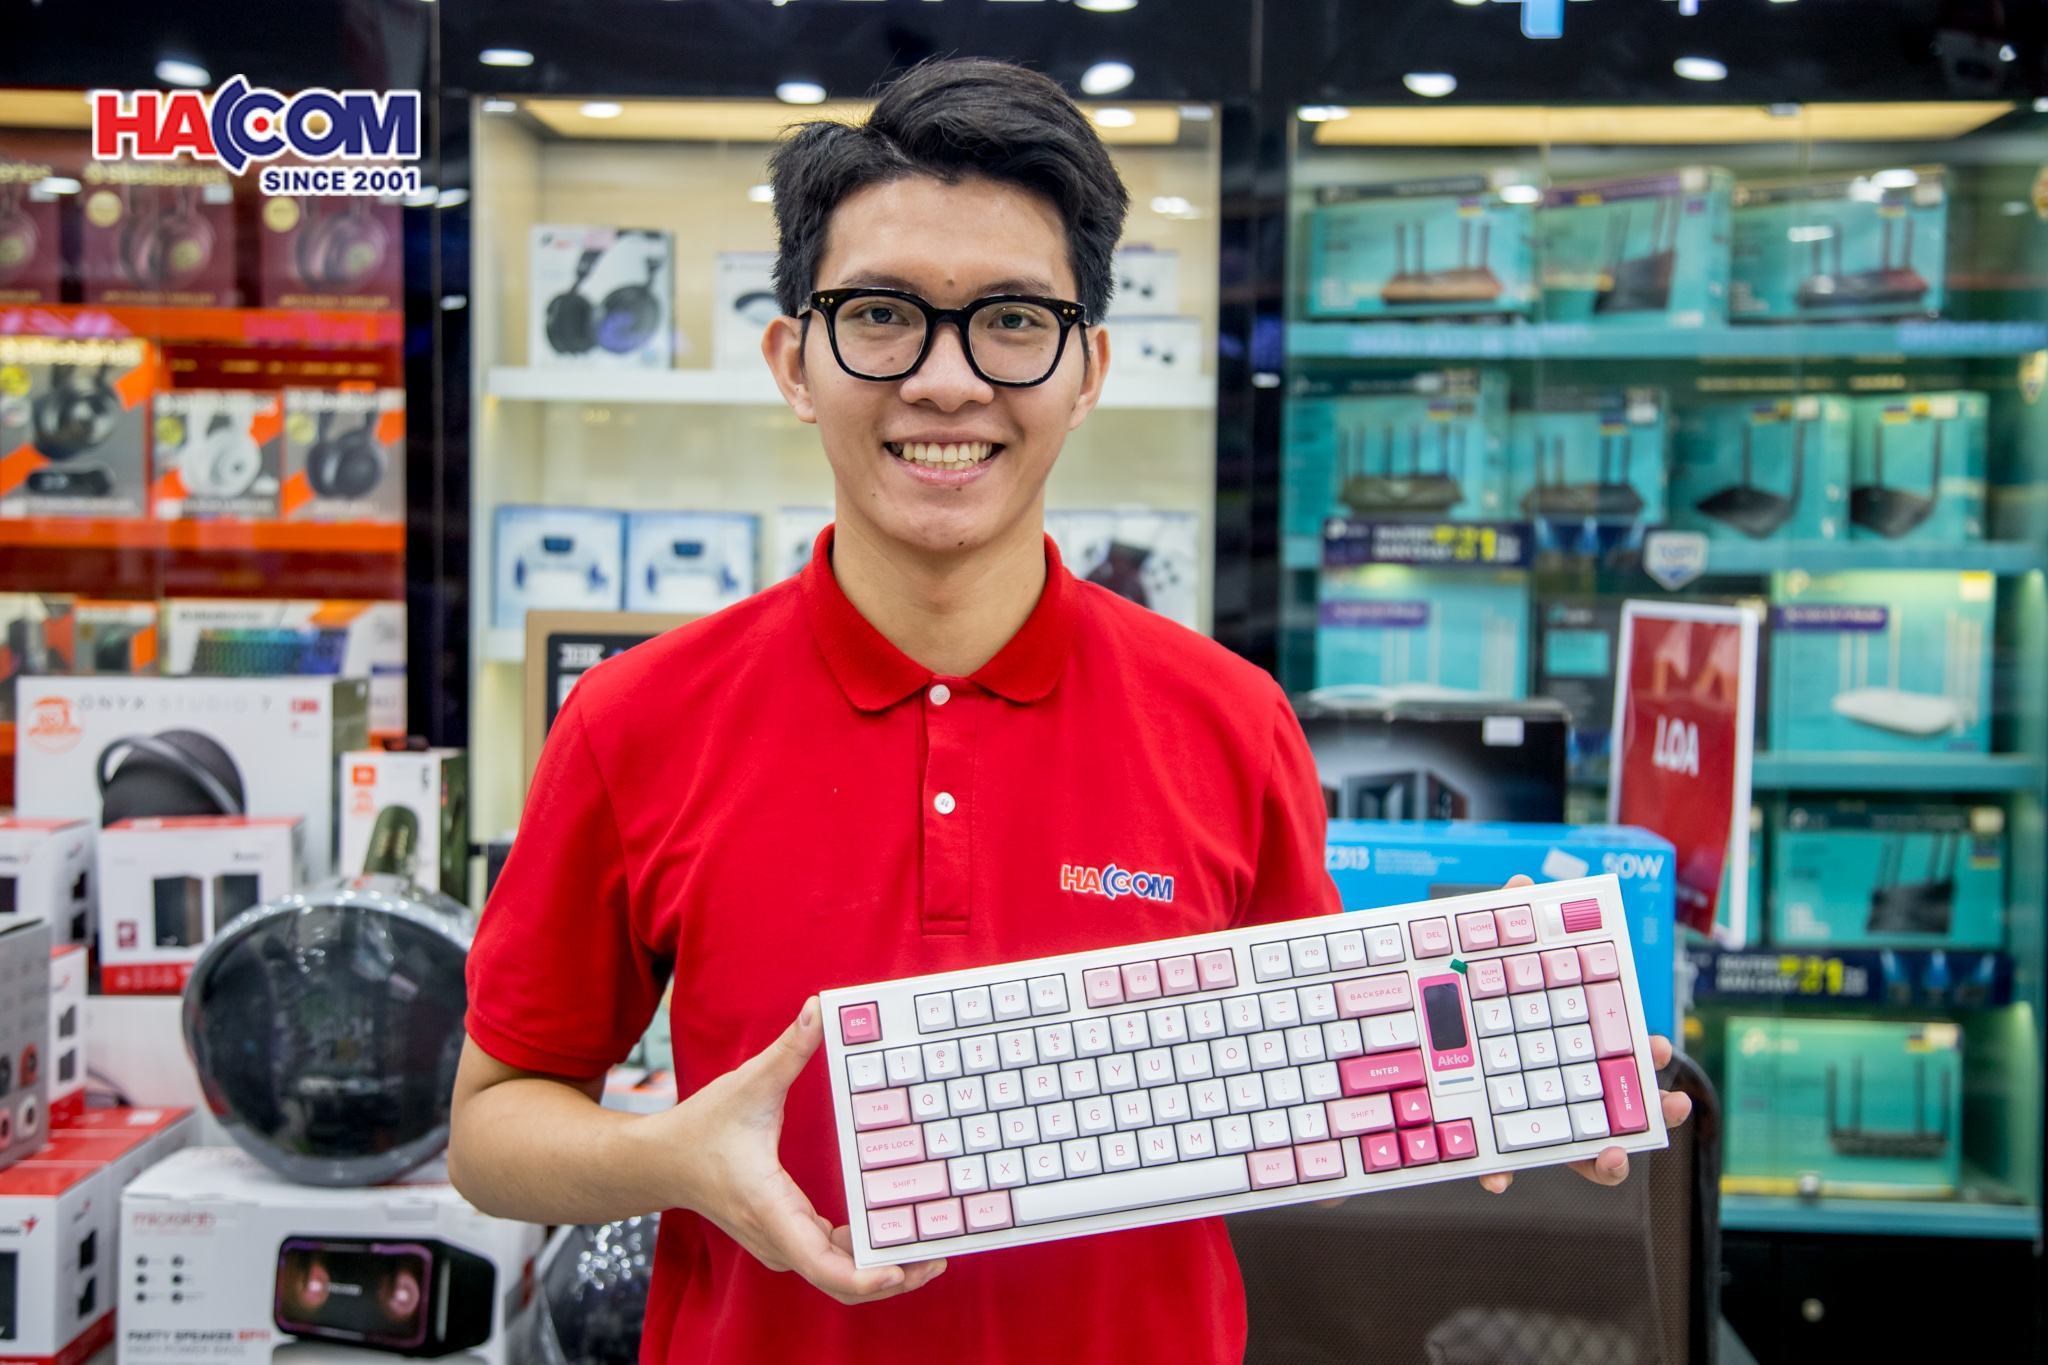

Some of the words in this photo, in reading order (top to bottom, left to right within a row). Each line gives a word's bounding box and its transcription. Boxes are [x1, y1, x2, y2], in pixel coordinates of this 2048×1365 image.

[1653, 714, 1699, 777] LOA
[1469, 923, 1493, 933] HOME
[1509, 918, 1528, 928] END
[1425, 931, 1442, 940] DEL
[1343, 943, 1356, 953] F11
[1379, 938, 1393, 947] F12
[1268, 954, 1280, 963] F9
[1304, 948, 1319, 958] F10
[1136, 974, 1148, 983] F6
[1174, 968, 1185, 976] F7
[1481, 968, 1499, 977] NUM
[1098, 979, 1111, 988] F5
[1480, 975, 1503, 986] LOCK
[1004, 994, 1017, 1003] F3
[1041, 989, 1054, 997] F4
[1350, 987, 1402, 1000] BACKSPACE
[929, 1006, 940, 1015] F1
[967, 1000, 978, 1009] F2
[1529, 1003, 1539, 1015] 8
[1567, 998, 1577, 1010] 9
[1491, 1008, 1500, 1021] 7
[850, 1017, 867, 1027] ESC
[1263, 1041, 1273, 1054] P
[1535, 1042, 1546, 1054] 5
[1573, 1037, 1583, 1050] 6
[1225, 1047, 1238, 1060] O
[1437, 1053, 1470, 1067] Akko
[1498, 1049, 1508, 1060] 4
[1111, 1064, 1122, 1077] Y
[1149, 1058, 1161, 1072] U
[1370, 1066, 1399, 1076] ENTER
[1037, 1076, 1048, 1089] R
[1074, 1070, 1084, 1083] T
[1582, 1074, 1592, 1087] 3
[998, 1082, 1009, 1095] E
[1241, 1087, 1251, 1099] L
[1543, 1080, 1554, 1093] 2
[1620, 1076, 1632, 1110] ENTER
[922, 1093, 934, 1106] Q
[957, 1087, 973, 1101] W
[1203, 1091, 1215, 1104] K
[871, 1103, 889, 1112] TAB
[1127, 1103, 1139, 1116] H
[1168, 1097, 1176, 1110] J
[1052, 1114, 1061, 1127] F
[1089, 1108, 1101, 1121] G
[1350, 1108, 1375, 1120] SHIFT
[975, 1126, 986, 1139] S
[1013, 1121, 1025, 1133] D
[1530, 1121, 1541, 1134] 0
[937, 1132, 948, 1145] A
[1152, 1138, 1164, 1152] N
[1189, 1132, 1203, 1146] M
[865, 1143, 889, 1153] CAPS
[891, 1139, 915, 1150] LOCK
[1114, 1144, 1126, 1157] B
[1038, 1155, 1049, 1169] C
[1075, 1150, 1087, 1163] V
[1314, 1156, 1328, 1165] FN
[999, 1162, 1011, 1177] X
[1265, 1162, 1281, 1172] ALT
[961, 1167, 972, 1181] Z
[892, 1178, 917, 1189] SHIFT
[979, 1205, 994, 1215] ALT
[930, 1214, 949, 1223] WIN
[880, 1220, 903, 1231] CTRL
